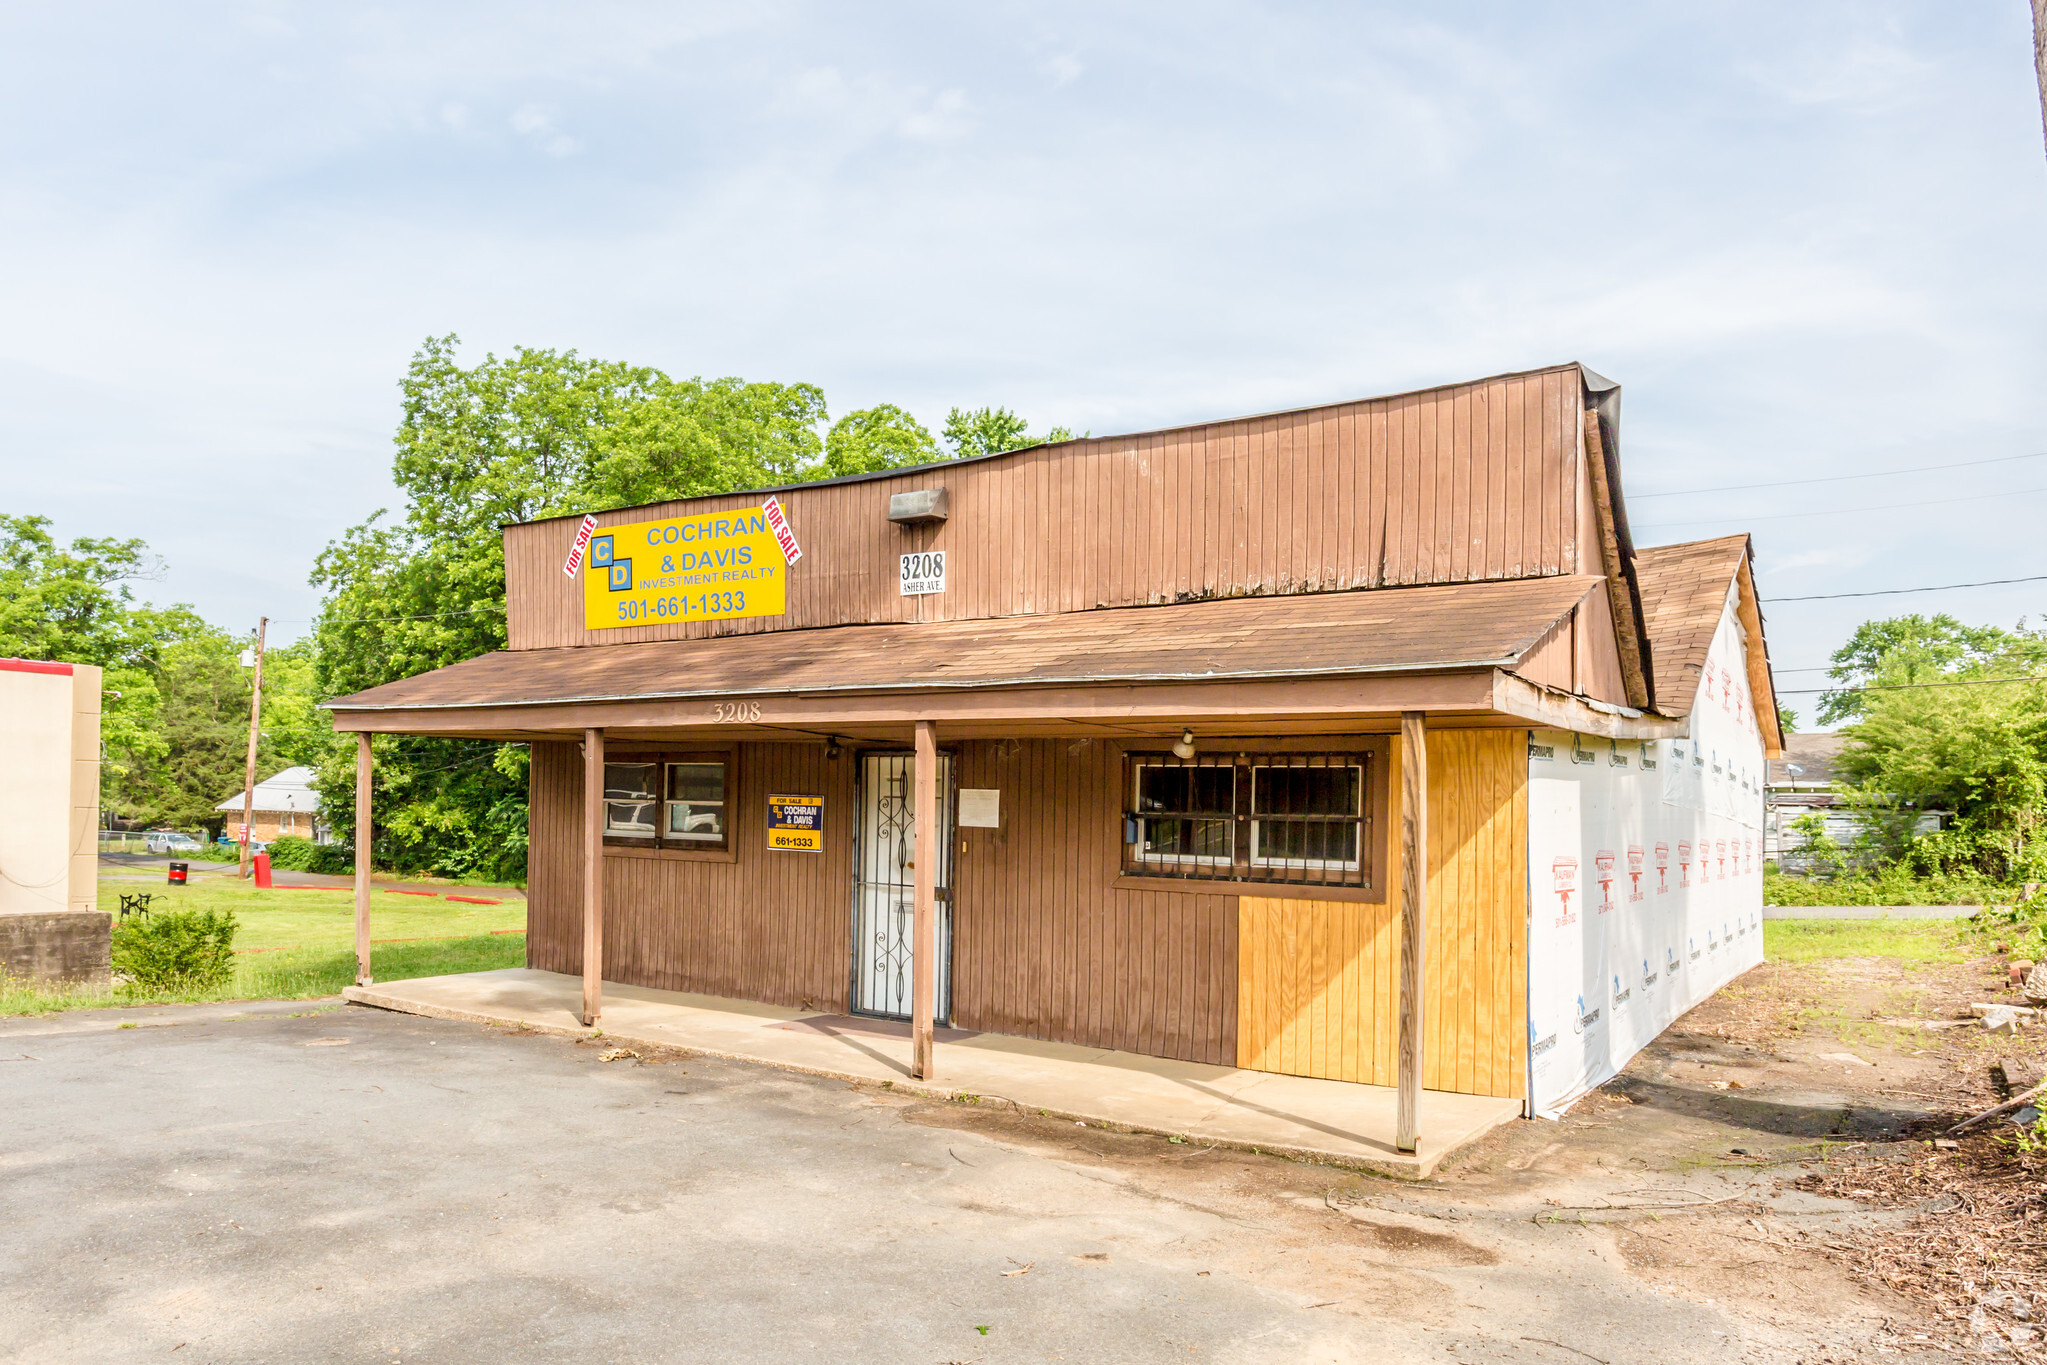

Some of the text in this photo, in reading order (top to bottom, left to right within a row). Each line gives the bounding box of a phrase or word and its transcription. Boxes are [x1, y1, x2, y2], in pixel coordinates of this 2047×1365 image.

[647, 514, 765, 546] COCHRAN
[764, 500, 799, 562] FOR SALE
[566, 517, 595, 575] FOR SALE
[595, 542, 609, 561] C
[661, 546, 752, 573] & DAVIS
[902, 553, 943, 580] 3208
[613, 565, 627, 585] D
[639, 566, 775, 590] INVESTMENT REALTY
[903, 581, 924, 593] ASHER
[618, 590, 745, 620] 501-661-1333
[712, 701, 761, 722] 3208
[784, 806, 817, 815] COCHRAN
[787, 815, 813, 824] & DAVIS
[776, 836, 813, 847] 661-1333
